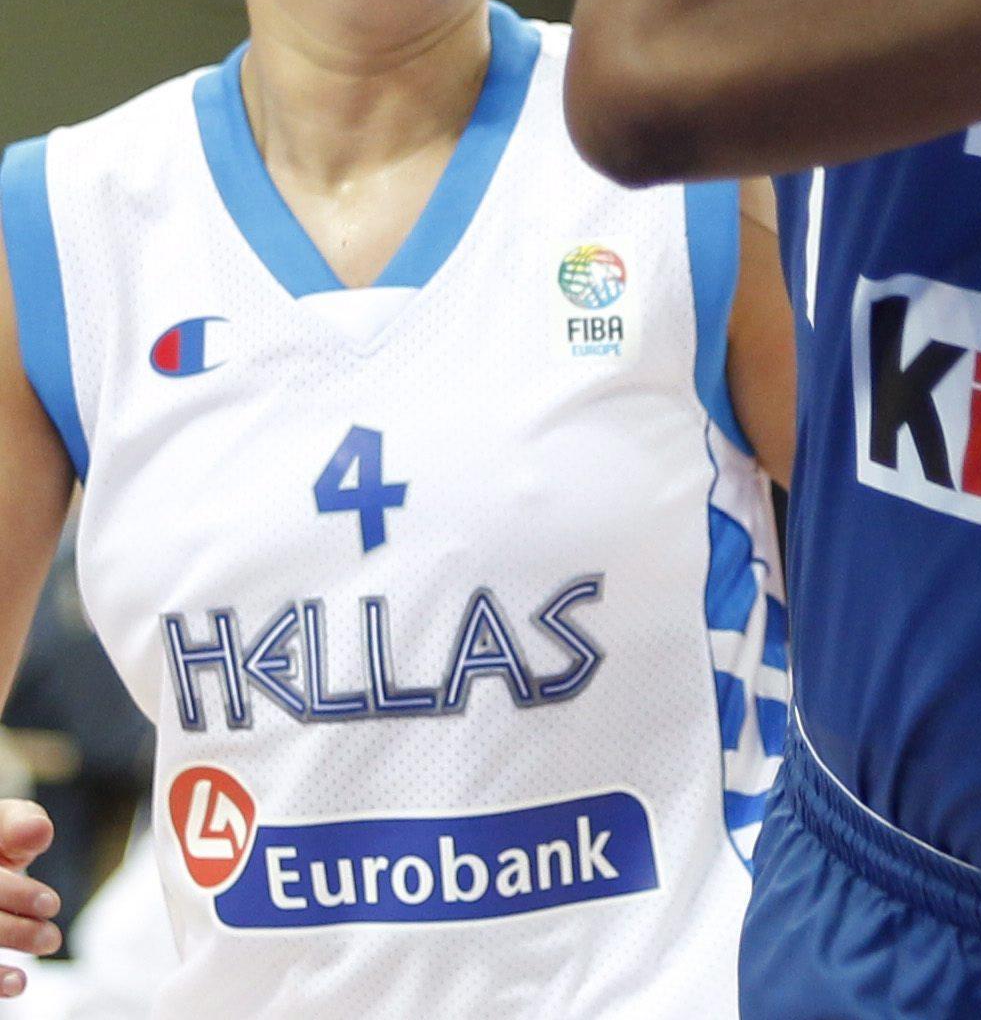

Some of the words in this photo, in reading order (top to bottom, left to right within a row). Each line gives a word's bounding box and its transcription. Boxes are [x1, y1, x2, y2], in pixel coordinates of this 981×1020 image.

[567, 315, 624, 342] FIBA
[314, 425, 408, 553] 4
[163, 574, 606, 732] HELLAS
[266, 816, 619, 909] Eurobank
